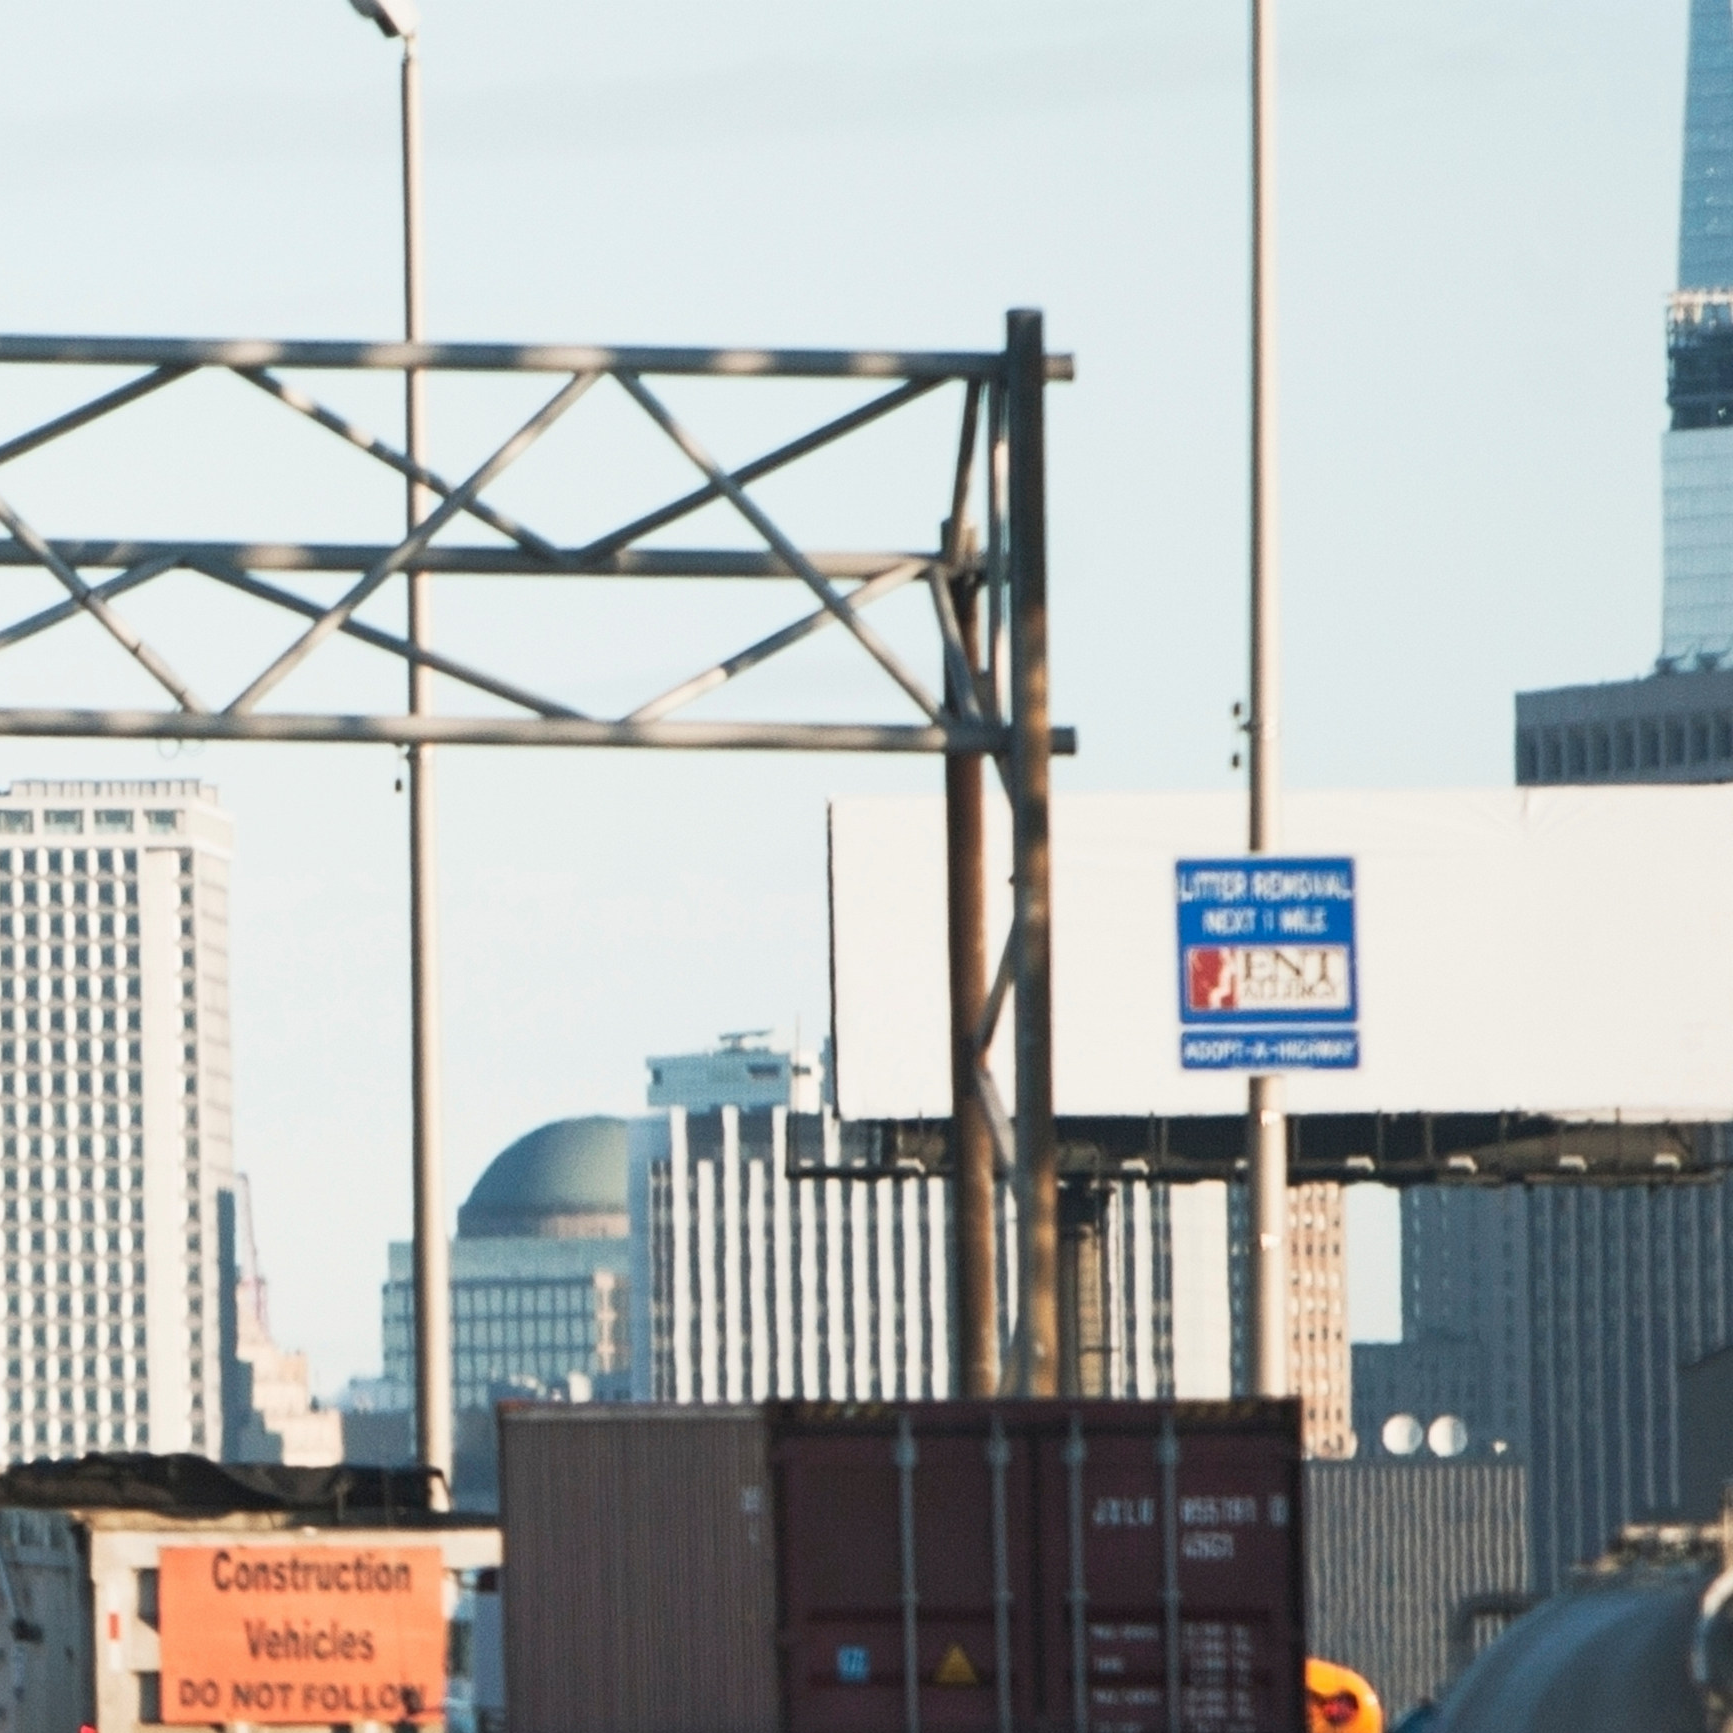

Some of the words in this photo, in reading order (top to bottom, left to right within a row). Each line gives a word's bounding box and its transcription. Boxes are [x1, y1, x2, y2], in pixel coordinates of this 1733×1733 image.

[211, 1549, 413, 1594] Construction
[243, 1618, 376, 1661] Vehicles
[178, 1678, 220, 1708] DO
[231, 1681, 294, 1712] NOT
